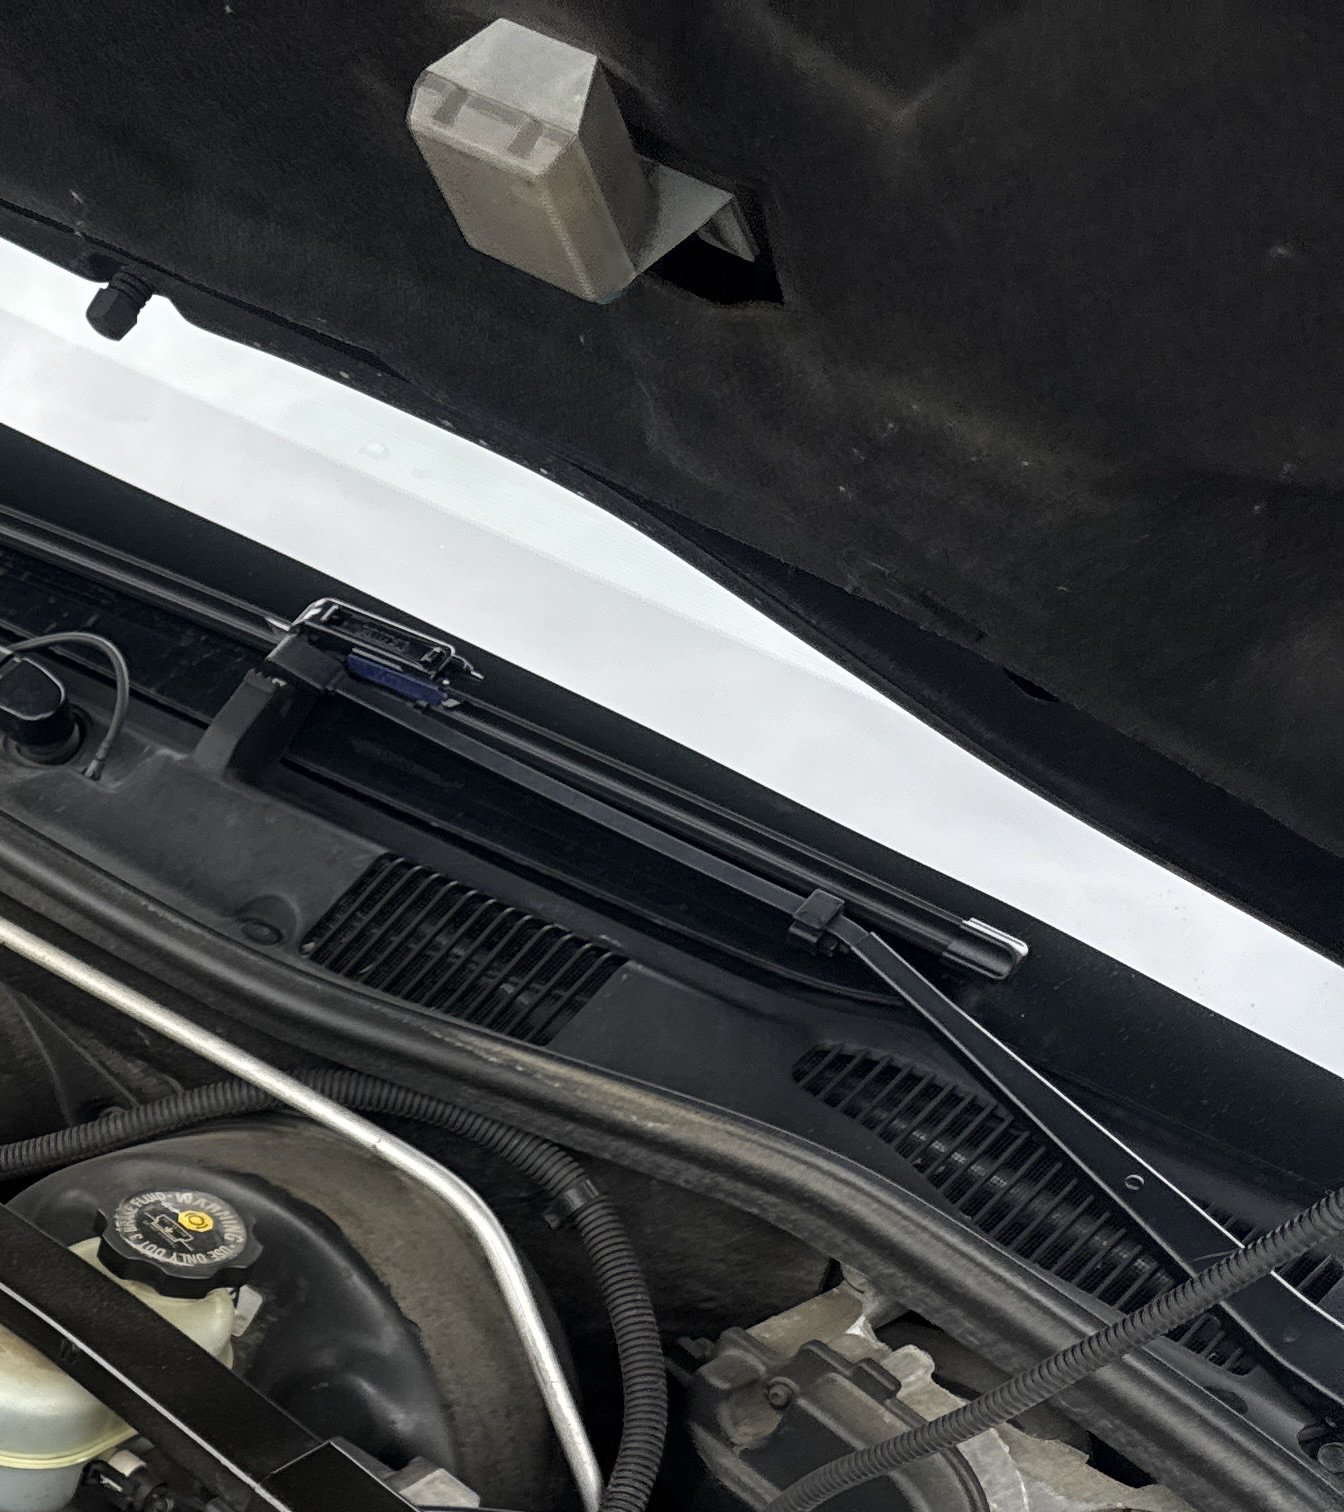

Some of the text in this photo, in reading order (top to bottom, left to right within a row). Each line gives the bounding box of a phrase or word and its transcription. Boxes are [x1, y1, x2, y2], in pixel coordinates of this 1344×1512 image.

[175, 1191, 245, 1243] WARNING
[129, 1233, 144, 1241] 3
[139, 1240, 167, 1260] DOT
[207, 1245, 231, 1261] USE
[170, 1252, 208, 1265] ONLY
